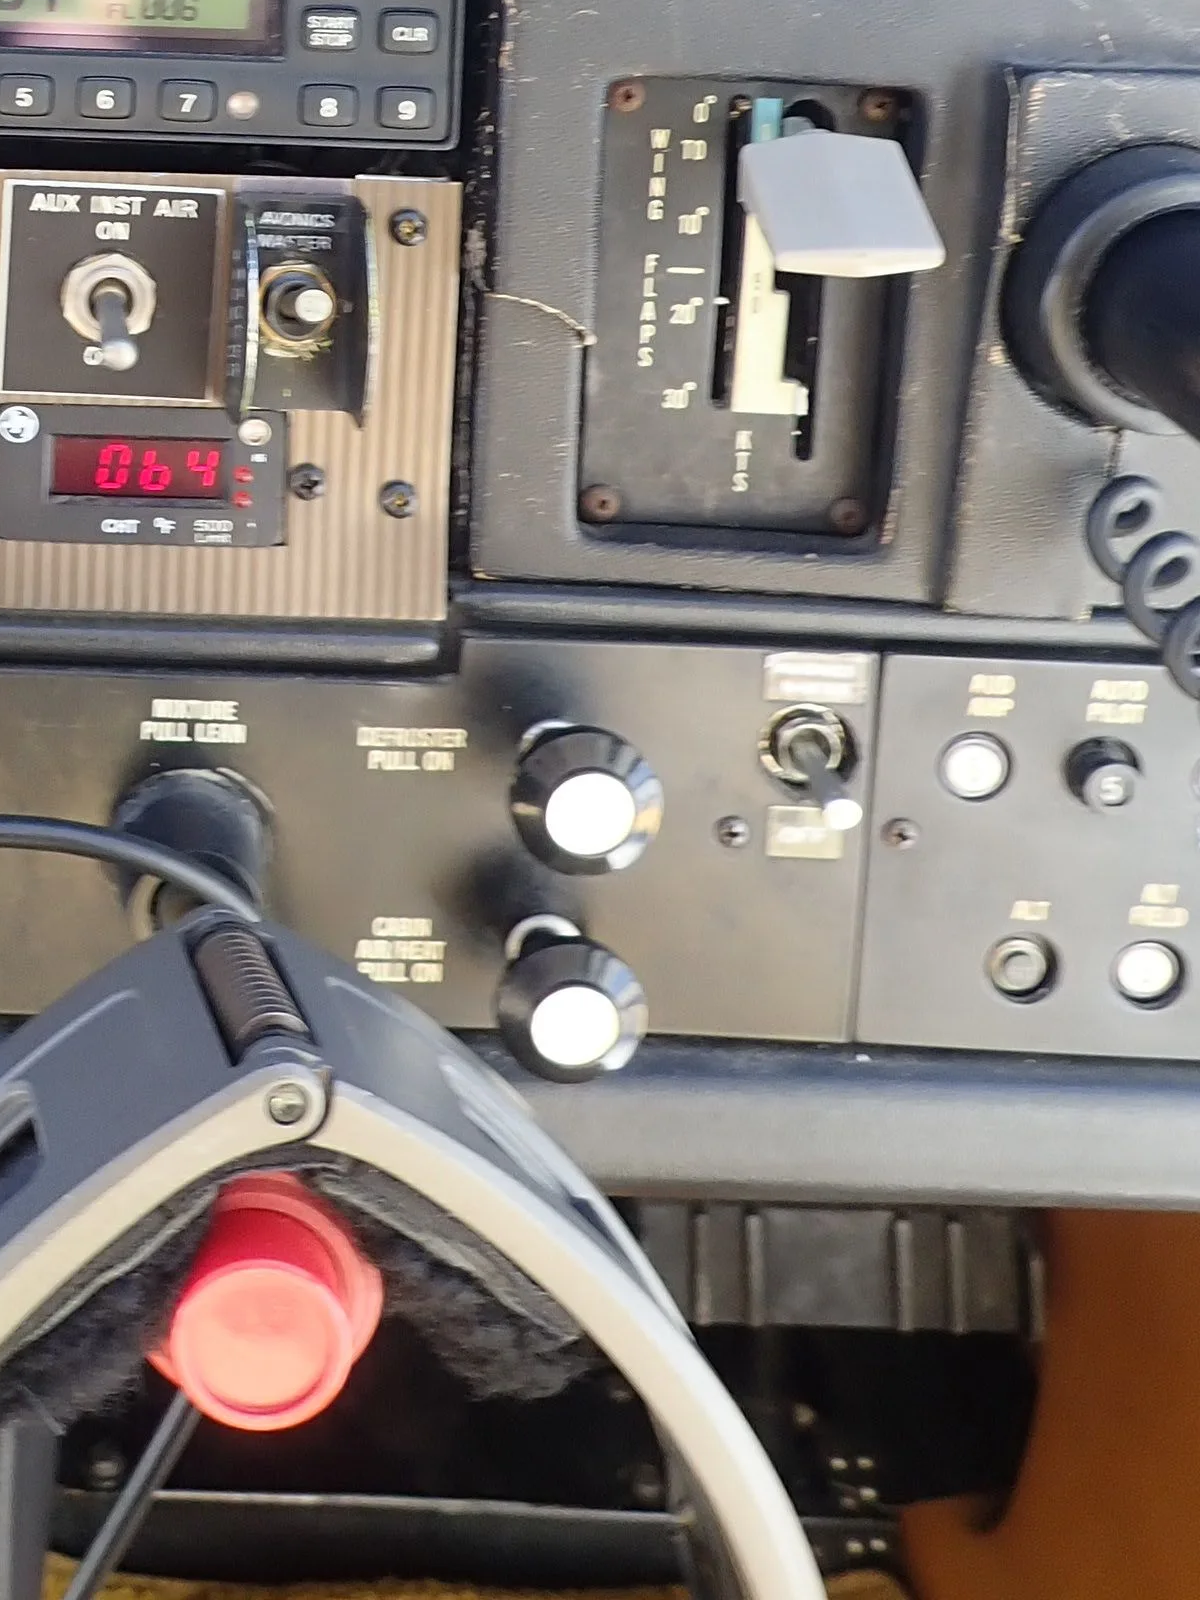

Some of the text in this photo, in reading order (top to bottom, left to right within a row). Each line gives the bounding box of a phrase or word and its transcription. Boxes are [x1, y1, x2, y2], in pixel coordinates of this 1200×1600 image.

[106, 3, 135, 20] FL
[391, 27, 427, 41] CLR
[15, 88, 34, 107] 5
[96, 90, 115, 109] 6
[179, 94, 197, 112] 7
[319, 98, 338, 116] 8
[398, 101, 416, 119] 9
[647, 129, 671, 221] WING
[29, 193, 198, 218] AUX INST AIR
[259, 212, 335, 228] AVIONICS
[96, 220, 130, 241] ON
[257, 234, 332, 250] MASTER
[637, 253, 660, 367] FLAPS
[95, 443, 220, 491] 064
[140, 721, 192, 742] PULL
[410, 963, 443, 982] ON
